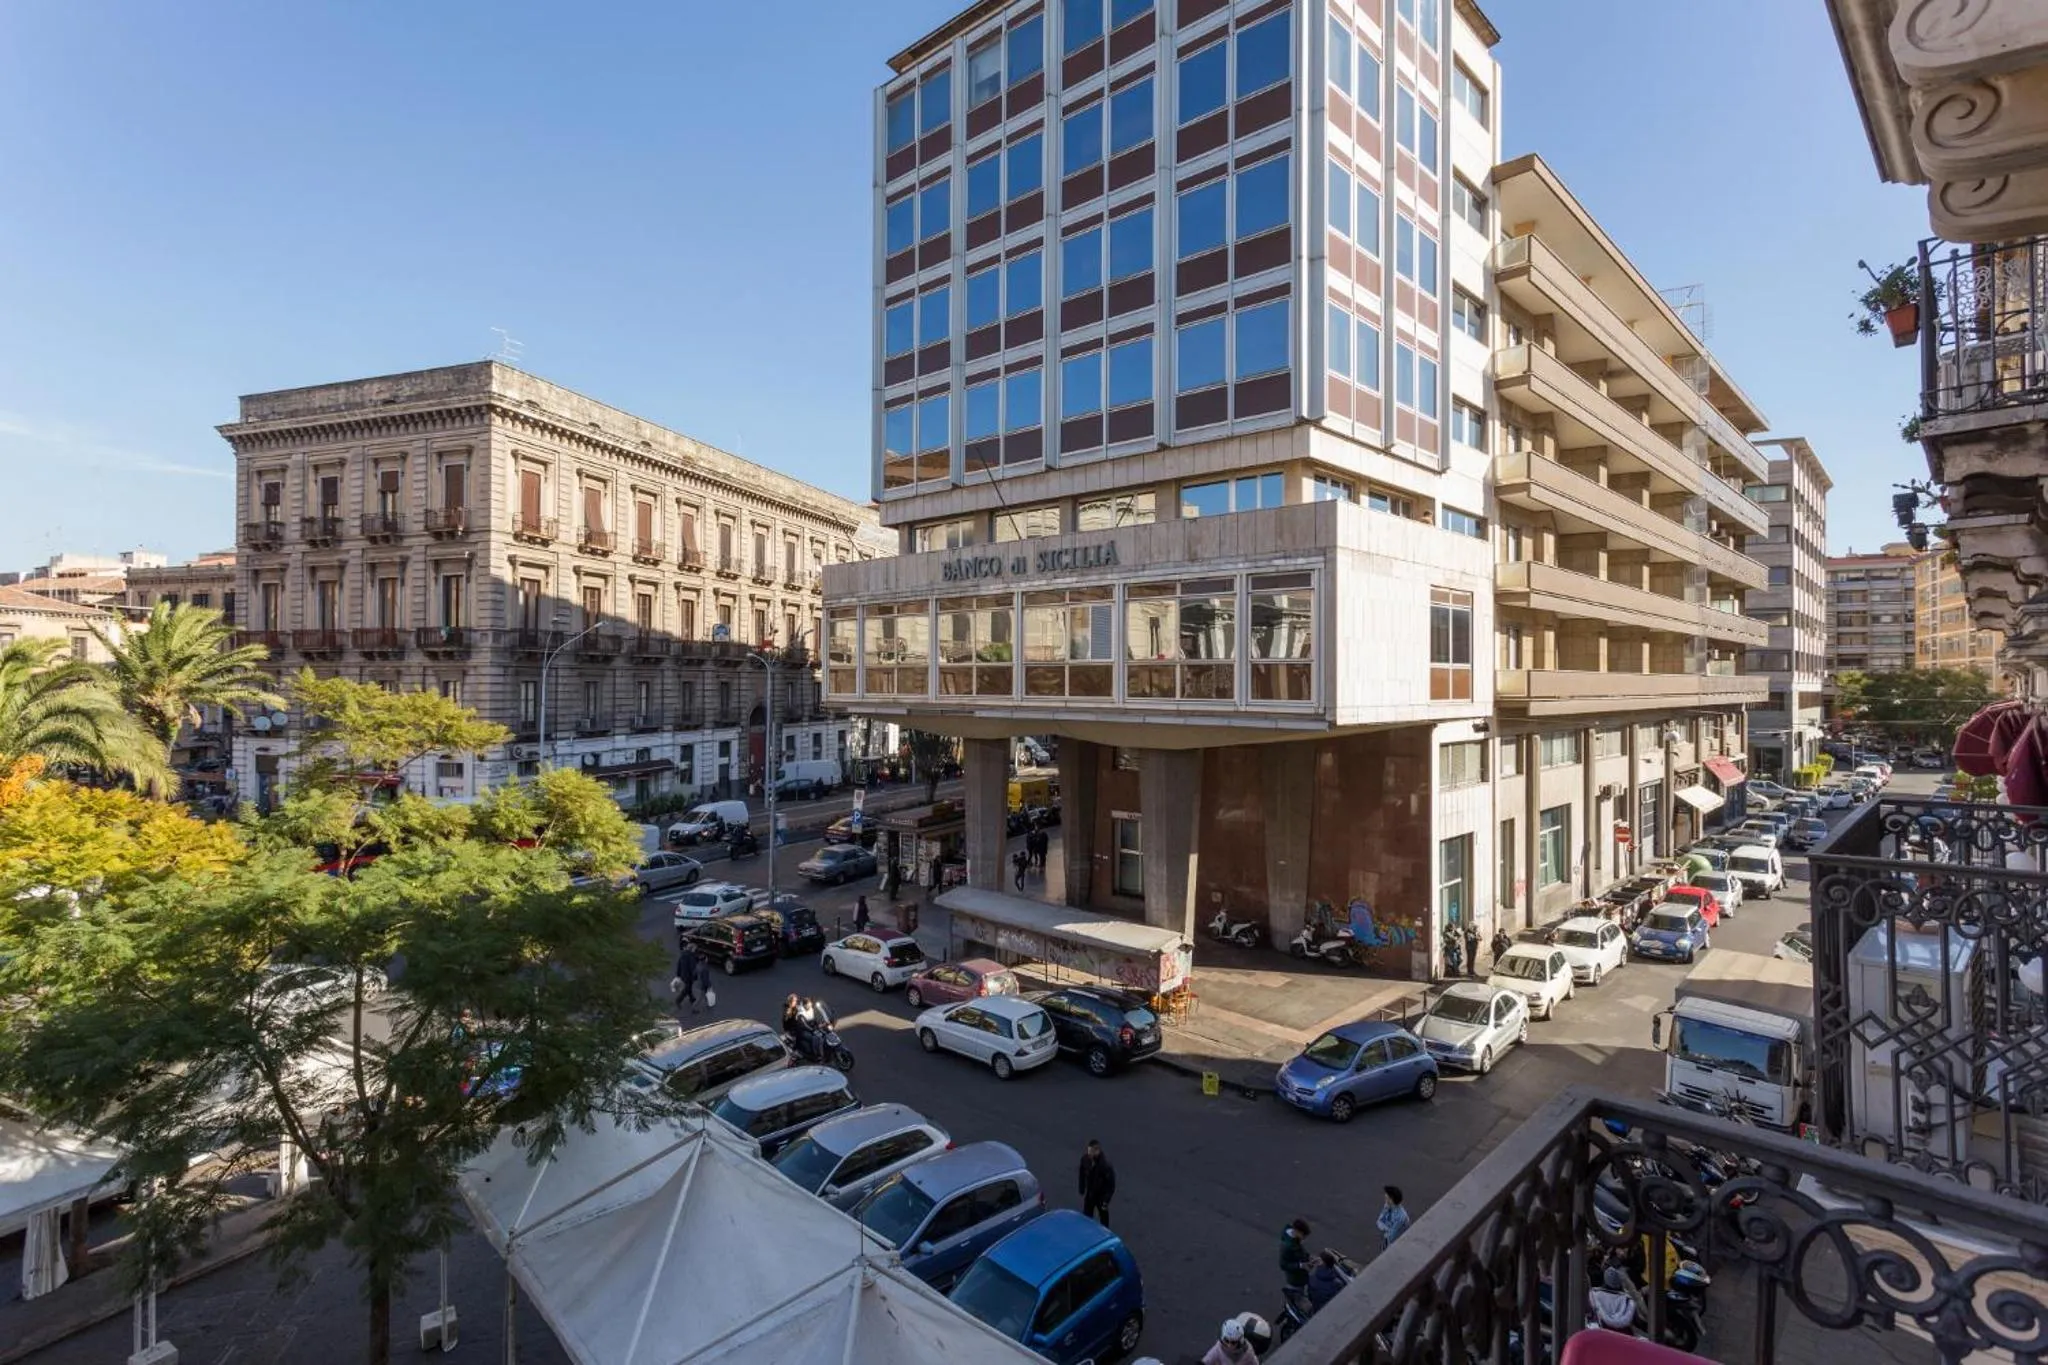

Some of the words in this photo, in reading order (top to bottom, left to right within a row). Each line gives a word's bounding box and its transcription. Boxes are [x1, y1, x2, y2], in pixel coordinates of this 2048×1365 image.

[942, 556, 1002, 581] BANCO
[1011, 556, 1027, 574] di
[1037, 541, 1120, 572] SICILIA
